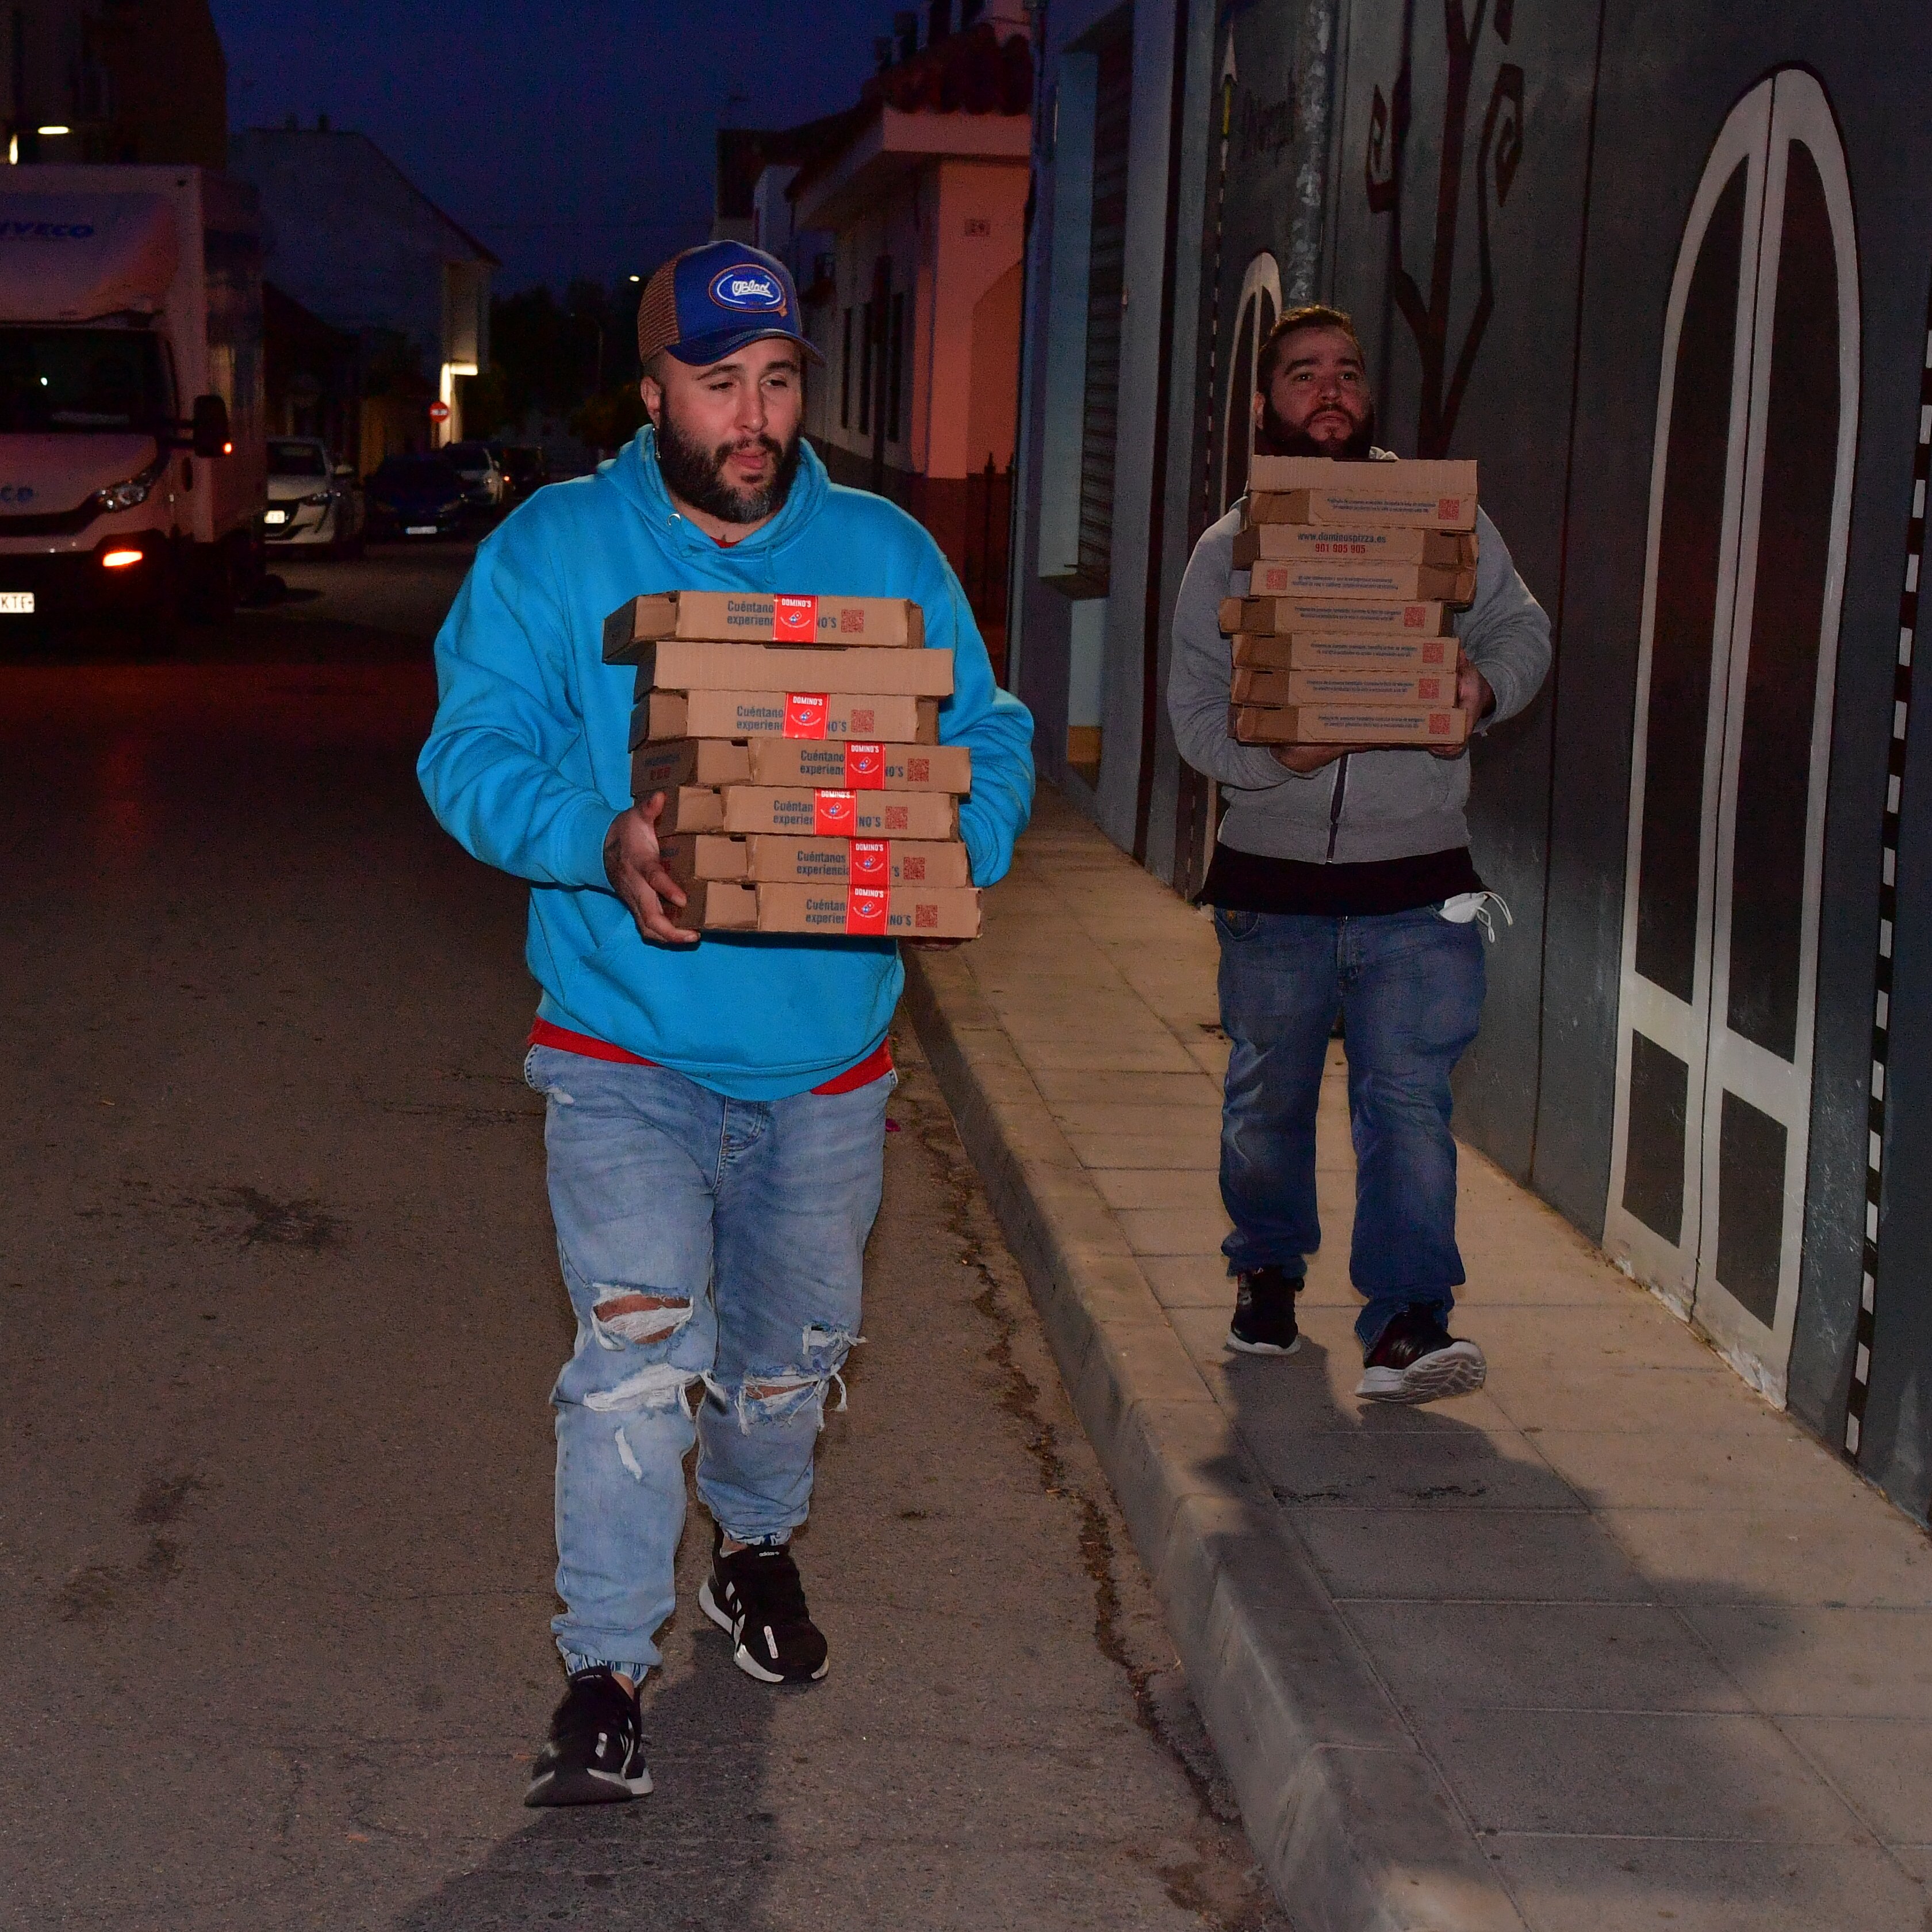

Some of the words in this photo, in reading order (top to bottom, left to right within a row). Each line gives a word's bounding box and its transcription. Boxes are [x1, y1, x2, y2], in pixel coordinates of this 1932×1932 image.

[1297, 532, 1386, 543] www.dominospizza.es
[1315, 543, 1329, 553] 901
[1333, 544, 1348, 553] 905
[1351, 544, 1366, 554] 905
[781, 598, 811, 608] DOMINO'S
[793, 696, 823, 706] DOMINO'S
[850, 745, 879, 753] DOMINO'S
[856, 843, 884, 852] DOMINO'S
[797, 850, 846, 863] Cuéntanos
[854, 888, 884, 898] DOMINO'S
